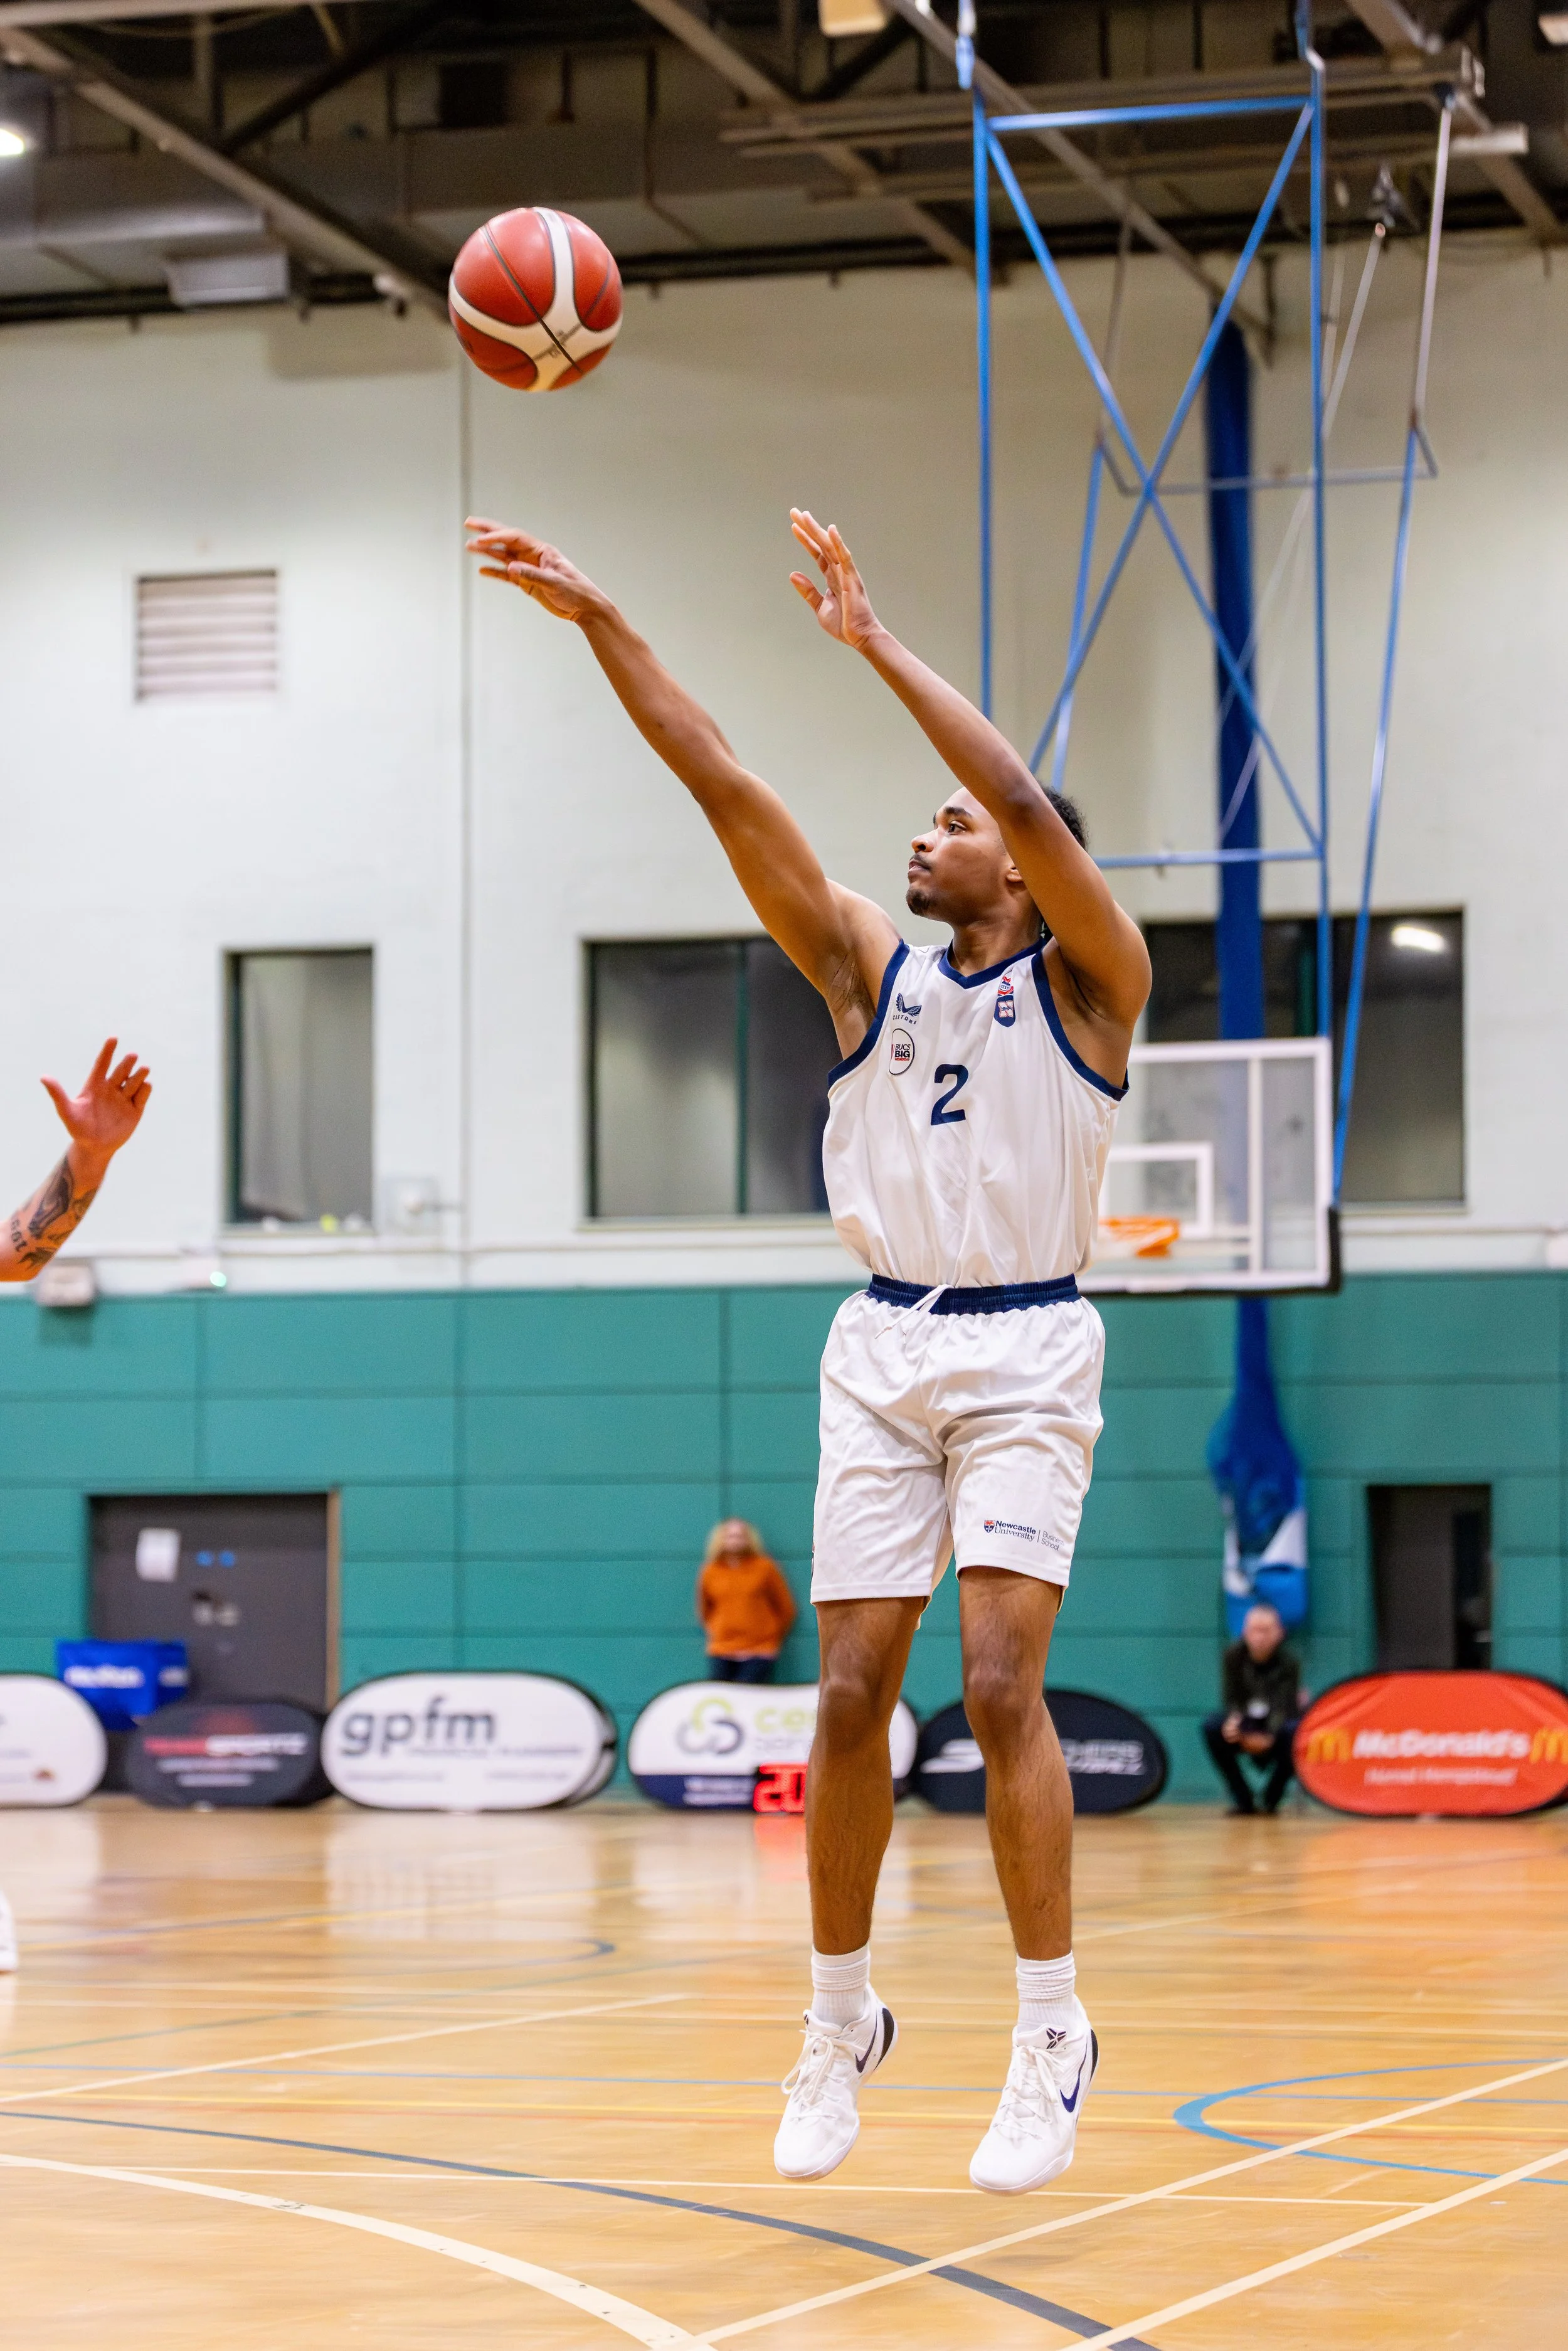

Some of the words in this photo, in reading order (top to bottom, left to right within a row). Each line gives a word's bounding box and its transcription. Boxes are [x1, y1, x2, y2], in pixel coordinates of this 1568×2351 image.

[930, 1063, 969, 1125] 2
[995, 1520, 1036, 1534] Newcastle
[995, 1527, 1035, 1541] University
[1041, 1539, 1059, 1551] School
[1042, 1531, 1064, 1546] Business
[341, 1696, 499, 1758] gpfm
[1353, 1729, 1530, 1759] McDonald's
